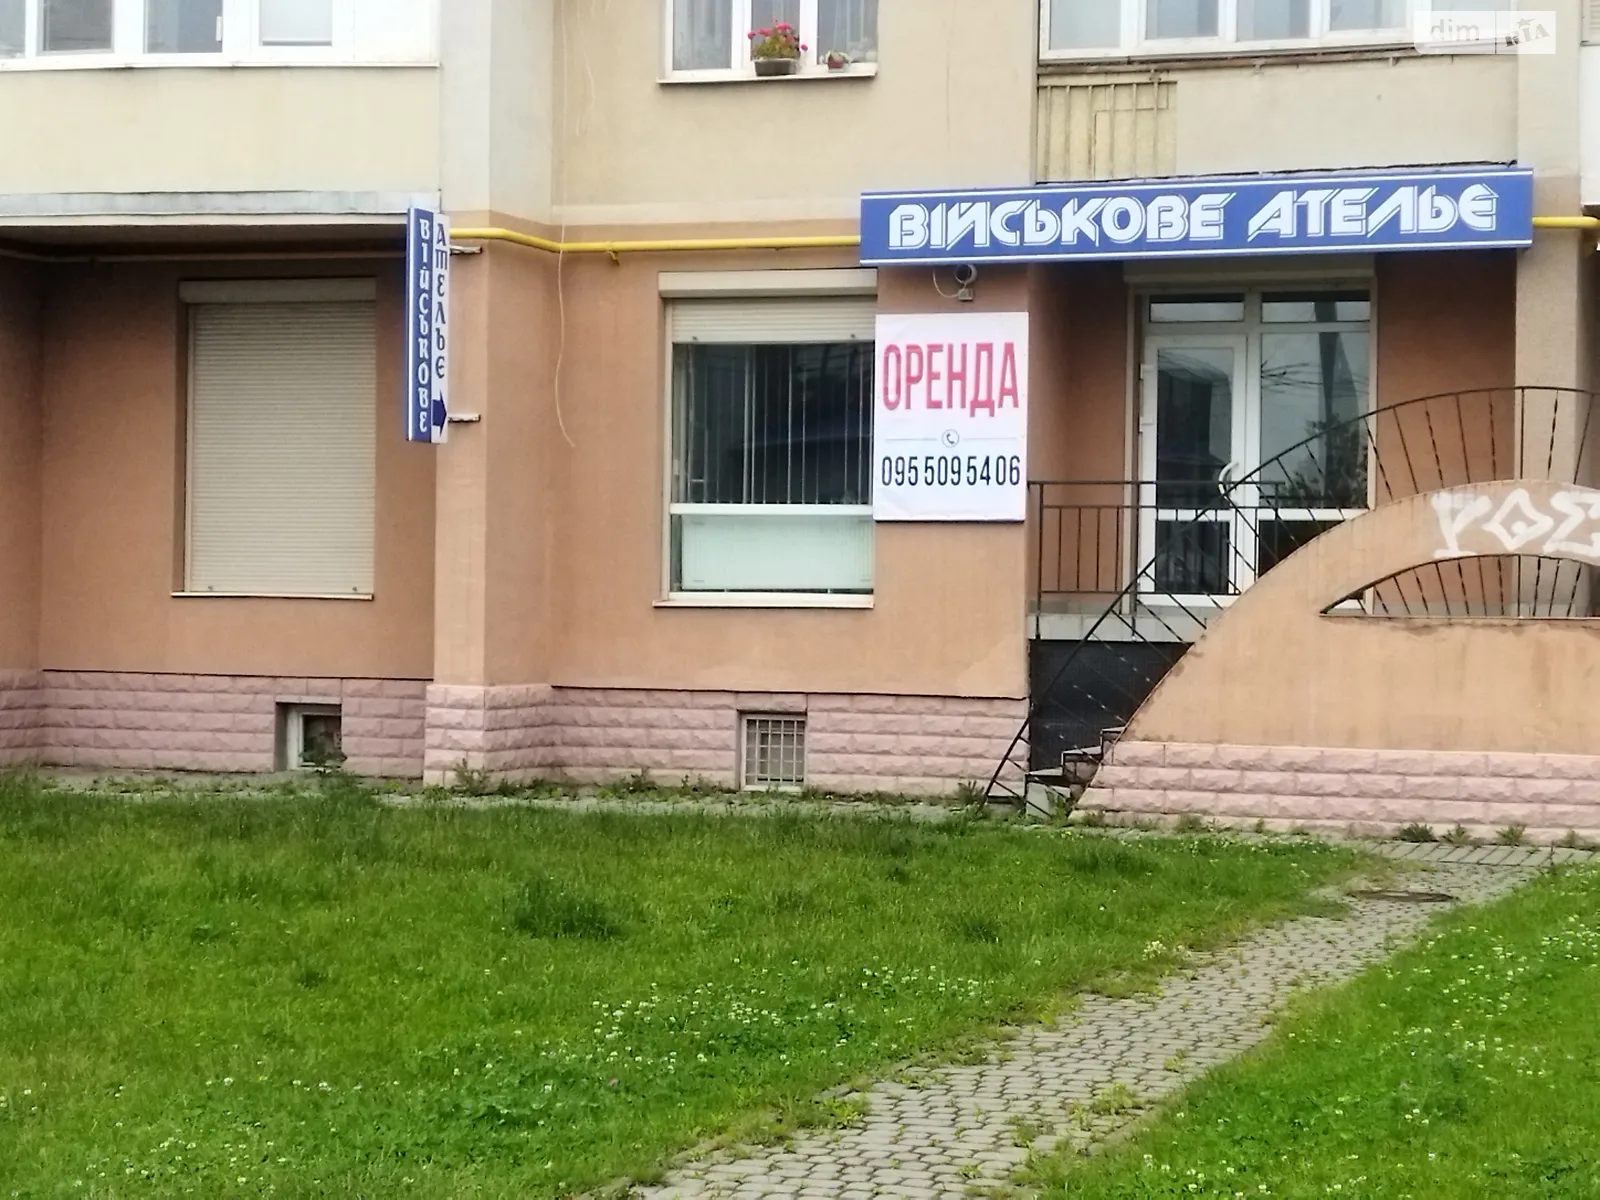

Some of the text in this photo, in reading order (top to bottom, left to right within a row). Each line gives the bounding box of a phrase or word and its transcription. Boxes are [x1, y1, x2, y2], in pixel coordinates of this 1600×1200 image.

[888, 182, 1500, 251] ВІЙСЬКОВЕ АТЕЛЬЄ
[882, 341, 1020, 418] ОРЕНДА
